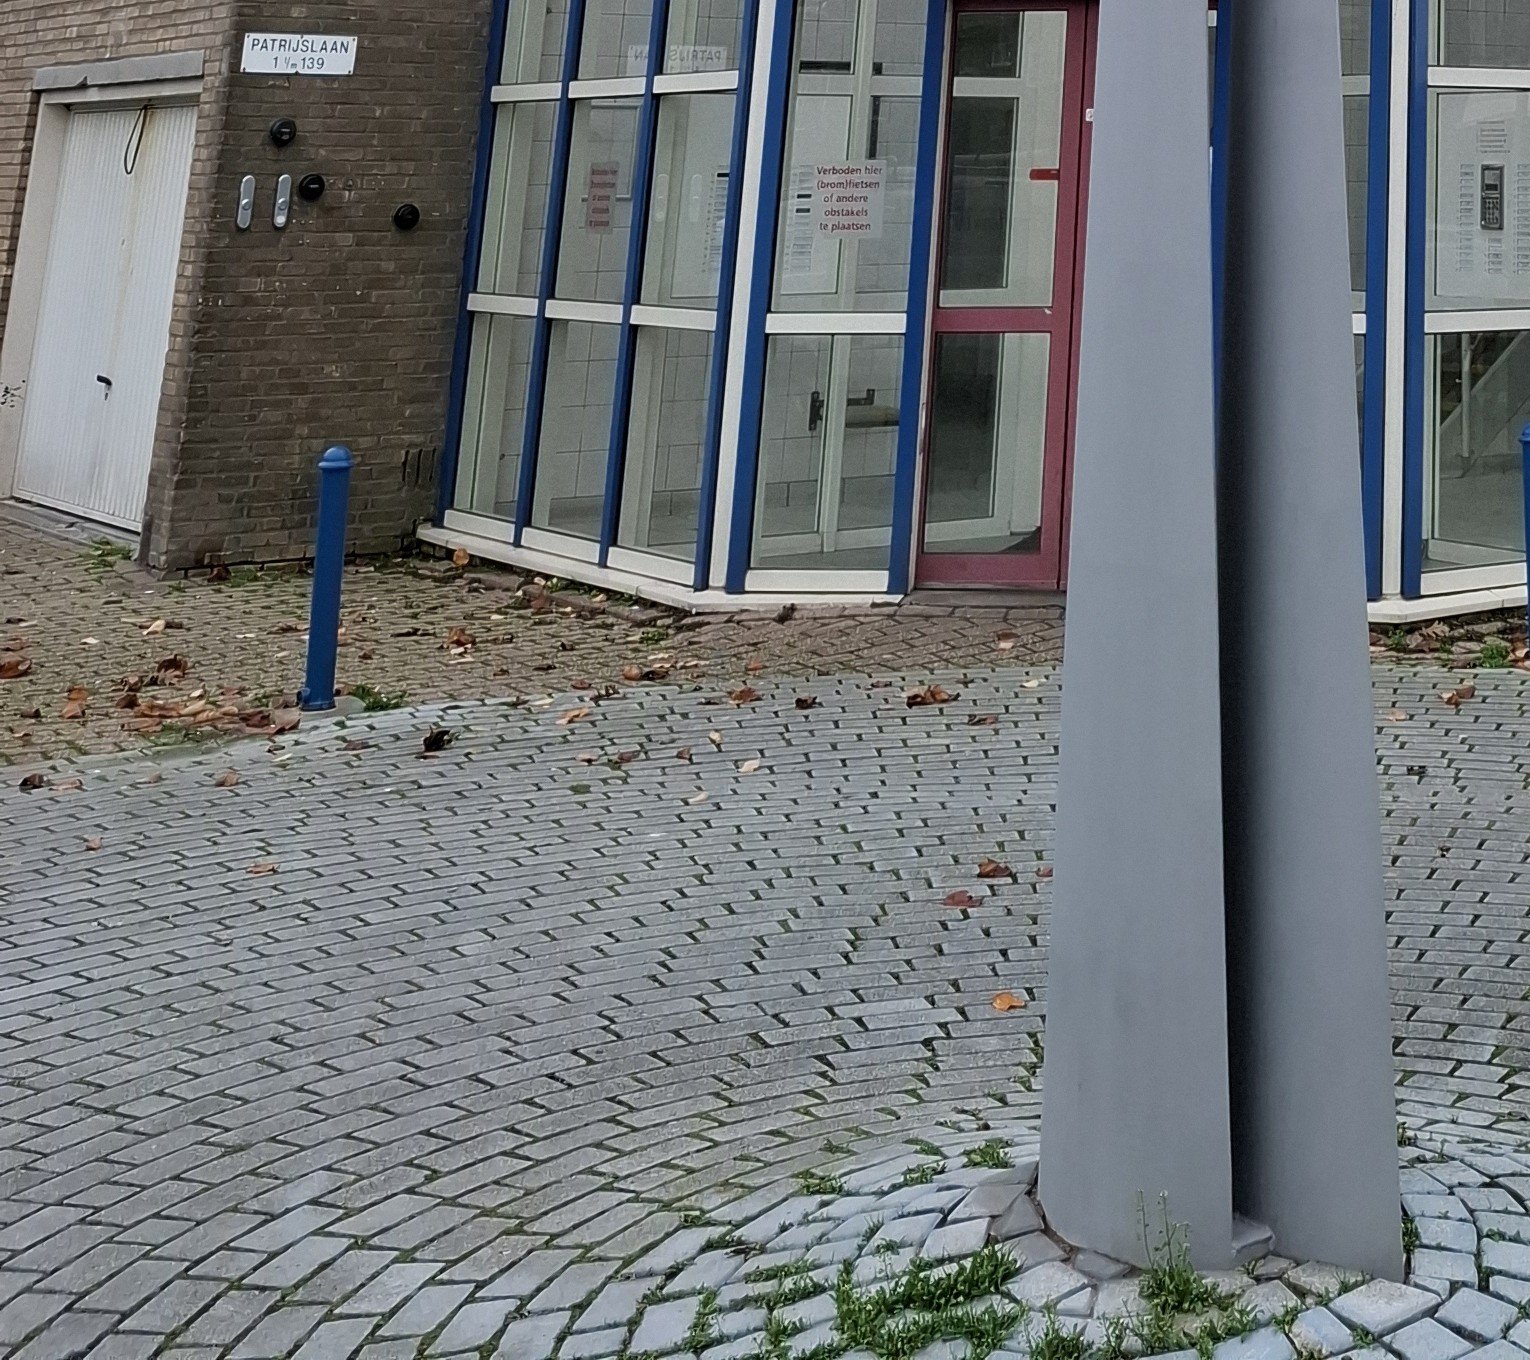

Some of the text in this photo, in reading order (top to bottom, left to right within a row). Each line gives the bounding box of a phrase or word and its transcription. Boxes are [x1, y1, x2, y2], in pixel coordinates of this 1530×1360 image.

[250, 38, 350, 54] PATRIJSLAAN
[273, 56, 279, 69] 1
[300, 56, 325, 70] 139
[816, 165, 883, 175] Verboden hier
[816, 178, 880, 191] (brom)fietsen
[823, 193, 869, 203] of andere
[824, 207, 869, 217] obstakels
[819, 221, 871, 233] te plaatsen
